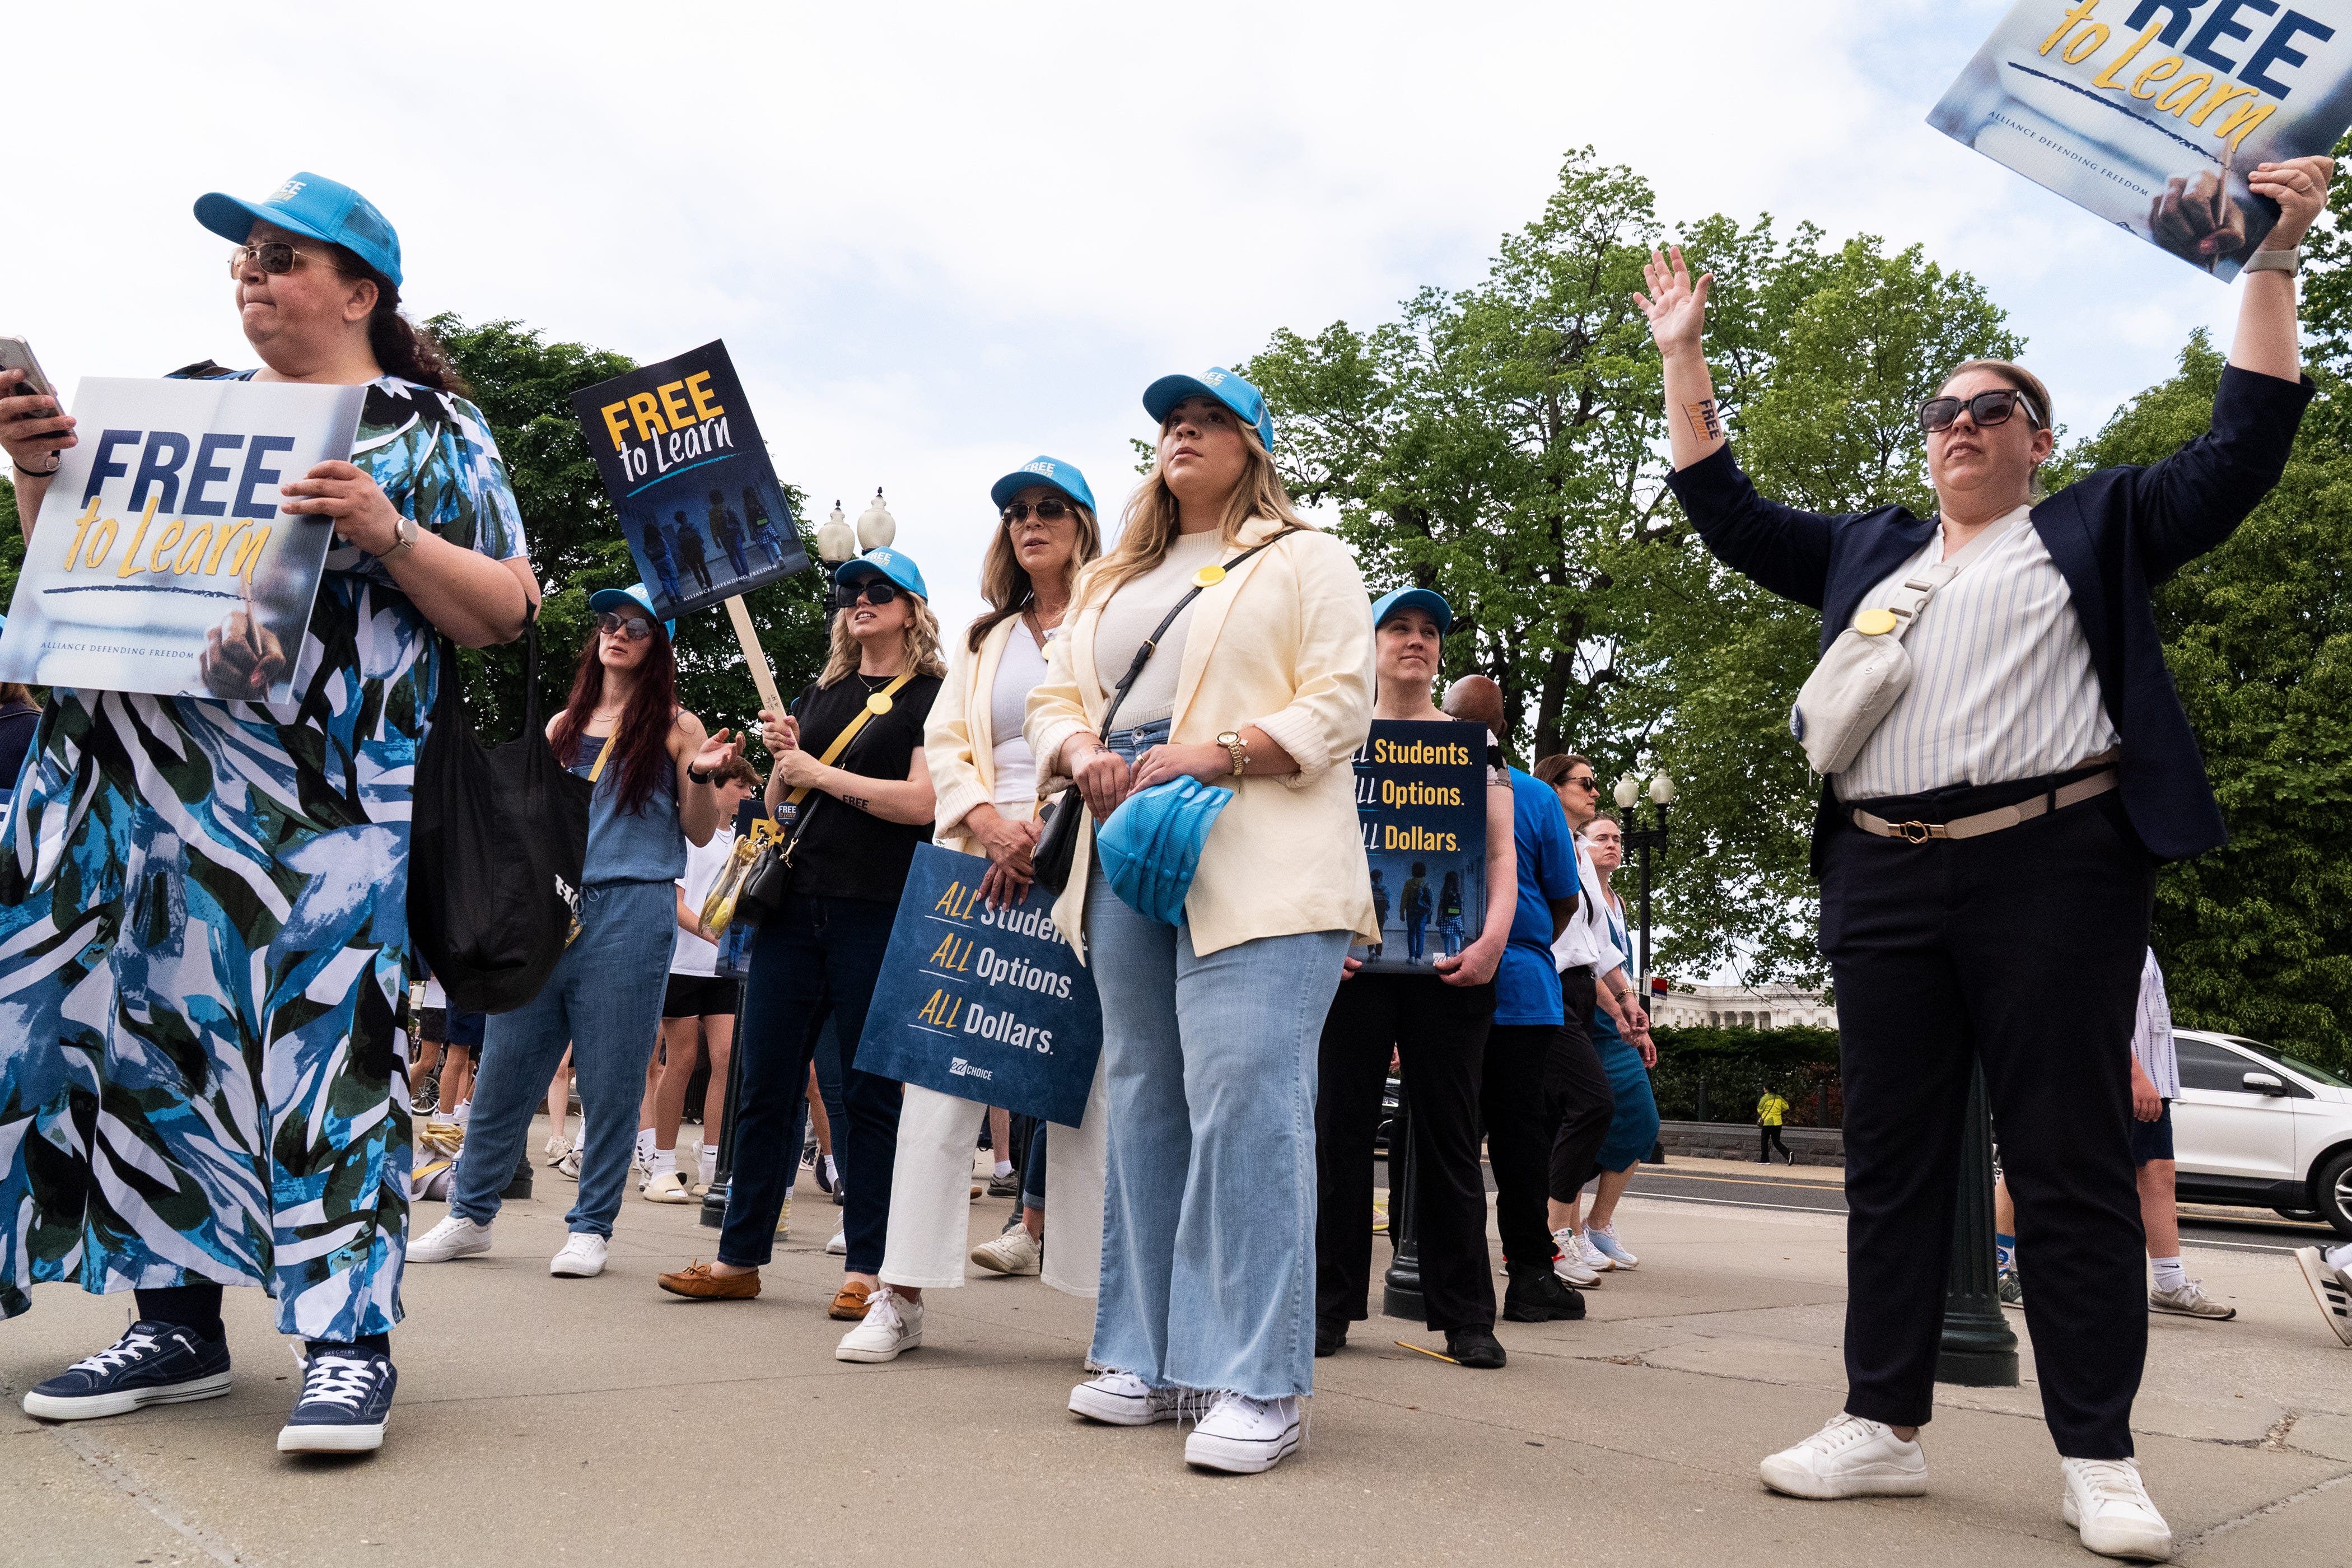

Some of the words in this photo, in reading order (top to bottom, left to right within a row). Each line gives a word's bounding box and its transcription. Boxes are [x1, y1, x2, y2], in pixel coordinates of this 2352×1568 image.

[2124, 0, 2336, 101] REE
[2038, 0, 2110, 64] to
[2091, 22, 2278, 153] Learn
[1988, 111, 2037, 138] ALLIANCE
[2038, 136, 2098, 170] DEFENDING
[2100, 168, 2149, 197] FREEDOM
[601, 370, 725, 451] FREE
[1698, 399, 1721, 440] FREE
[618, 441, 647, 482] to
[650, 416, 734, 473] Learn
[1024, 461, 1056, 473] FREE
[81, 429, 296, 520] FREE
[64, 497, 119, 572] to
[116, 496, 272, 585] Learn
[864, 552, 893, 562] FREE
[683, 587, 711, 602] ALLIANCE
[712, 575, 748, 590] DEFENDING
[749, 564, 778, 577] FREEDOM
[41, 642, 85, 651] ALLIANCE
[90, 645, 146, 655] DEFENDING
[149, 649, 194, 659] FREEDOM
[1375, 739, 1473, 766] Students.
[842, 795, 869, 809] FREE
[1354, 775, 1376, 804] LL
[1382, 779, 1465, 809] Options.
[1360, 821, 1379, 850] LL
[1385, 825, 1460, 852] Dollars.
[935, 881, 978, 921] ALL
[930, 932, 974, 972] ALL
[976, 947, 1074, 1001] Options.
[918, 989, 963, 1029] ALL
[964, 1003, 1054, 1055] Dollars.
